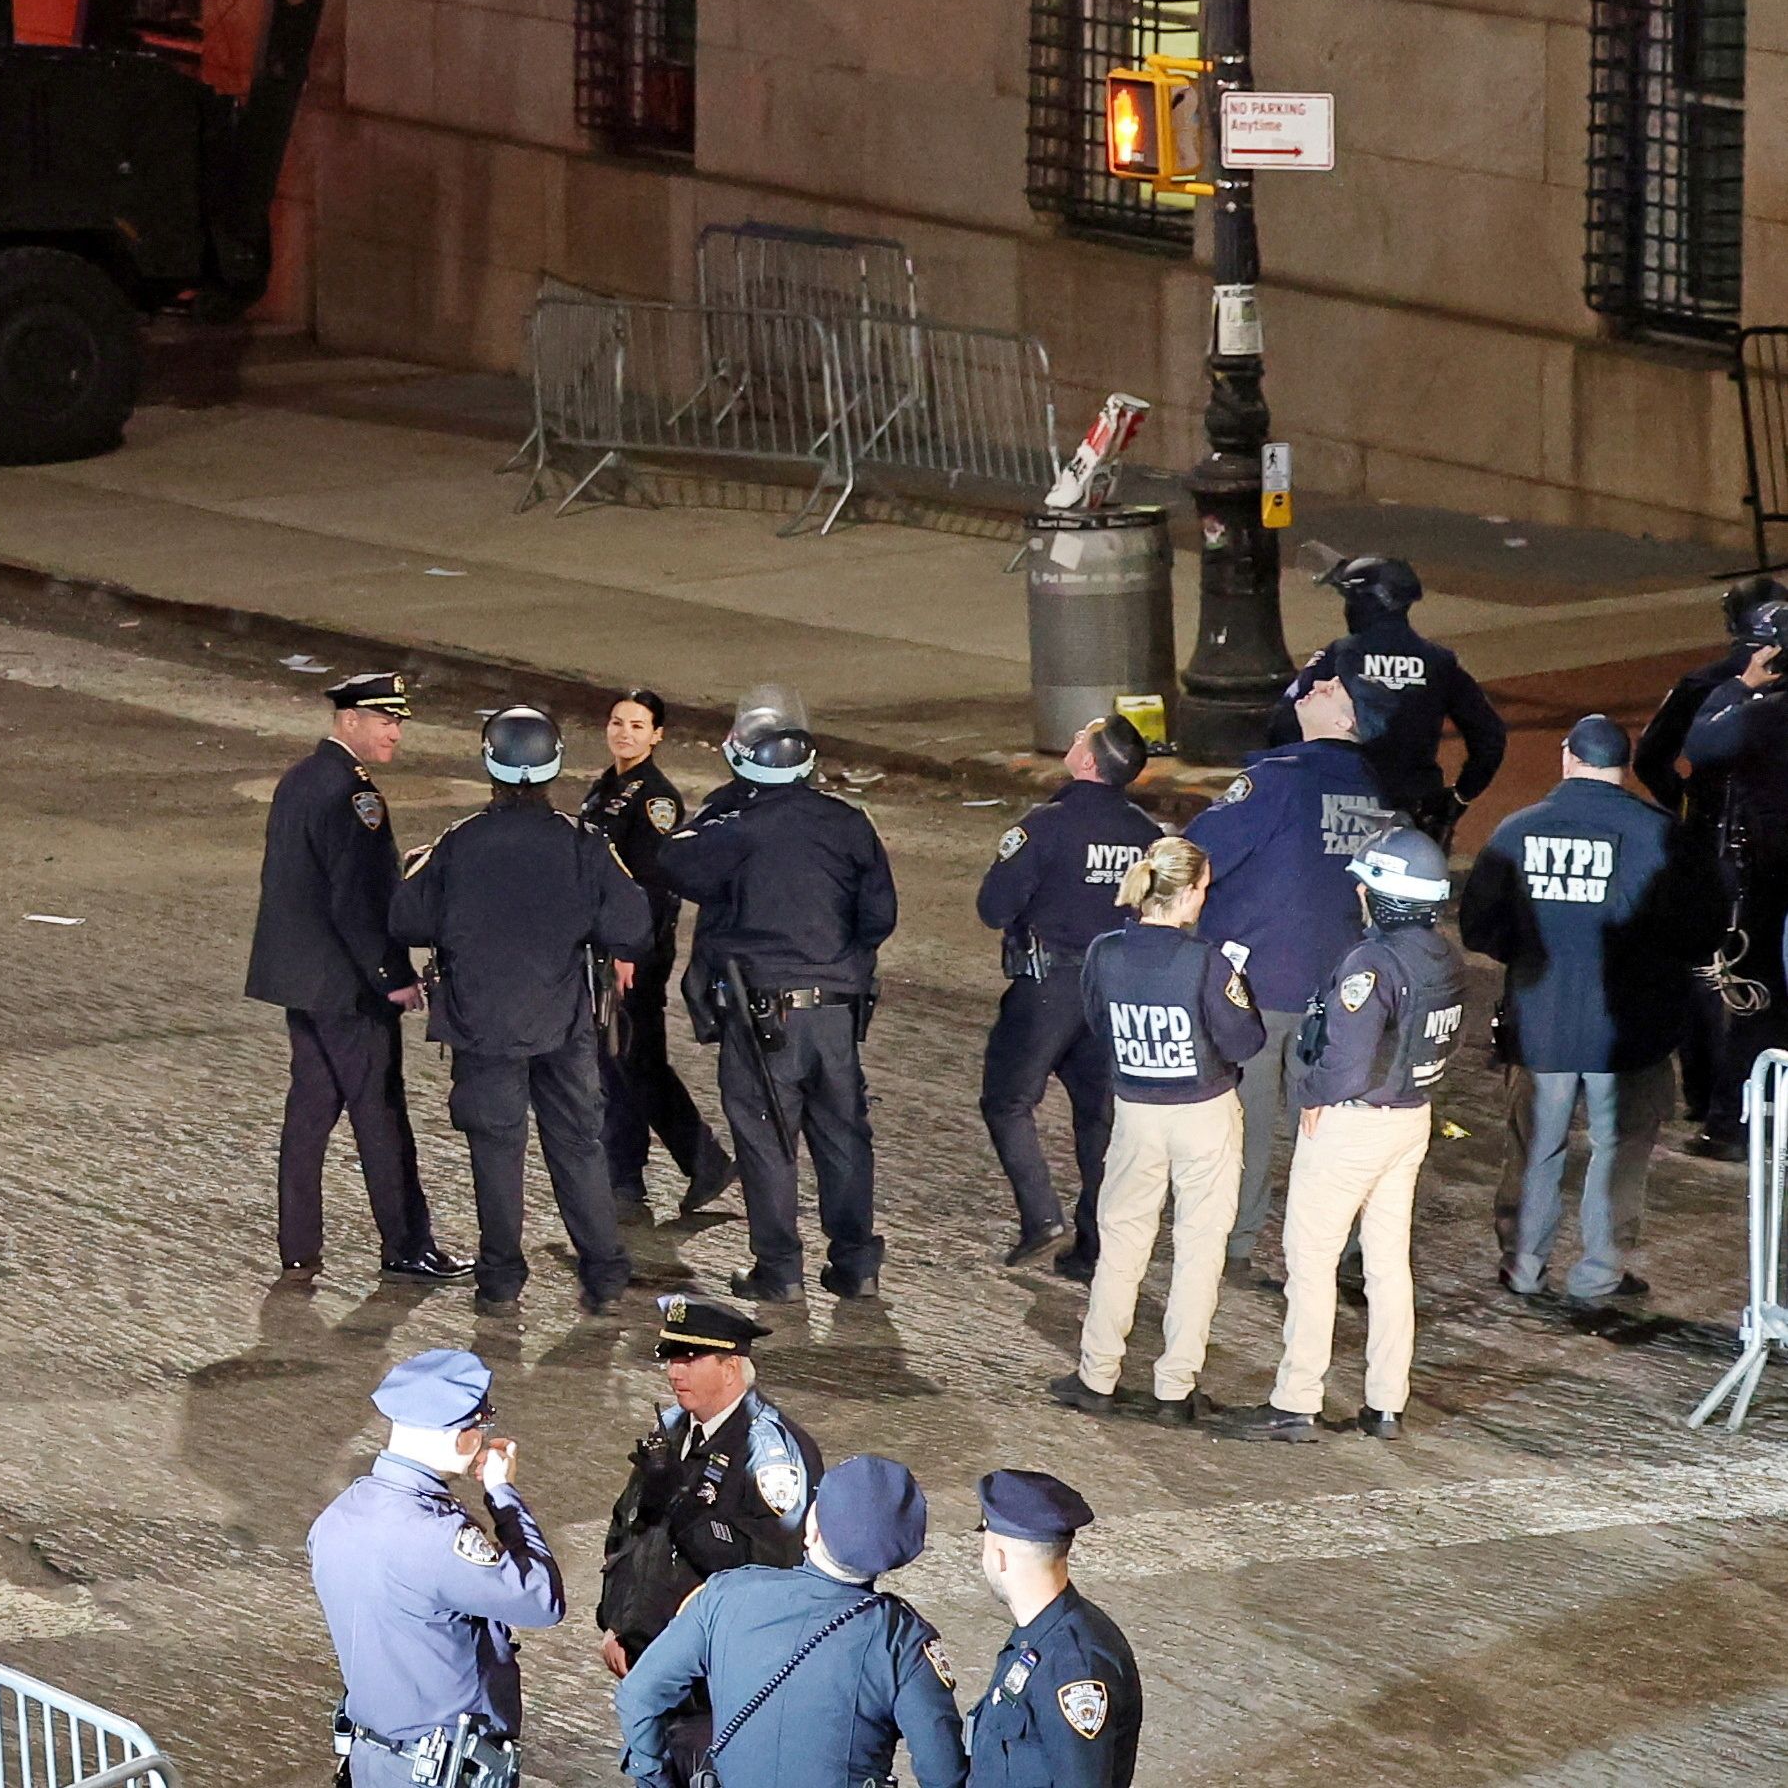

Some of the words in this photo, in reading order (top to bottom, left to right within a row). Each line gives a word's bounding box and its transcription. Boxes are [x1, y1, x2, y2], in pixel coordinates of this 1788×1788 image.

[1230, 102, 1247, 115] NO
[1252, 102, 1306, 116] PARKING
[1365, 654, 1424, 678] NYPD
[1086, 843, 1143, 869] NYPD
[1524, 836, 1613, 878] NYPD
[1527, 875, 1607, 903] TARU
[1109, 1001, 1191, 1041] NYPD
[1424, 1004, 1463, 1039] NYPD
[1114, 1037, 1196, 1068] POLICE
